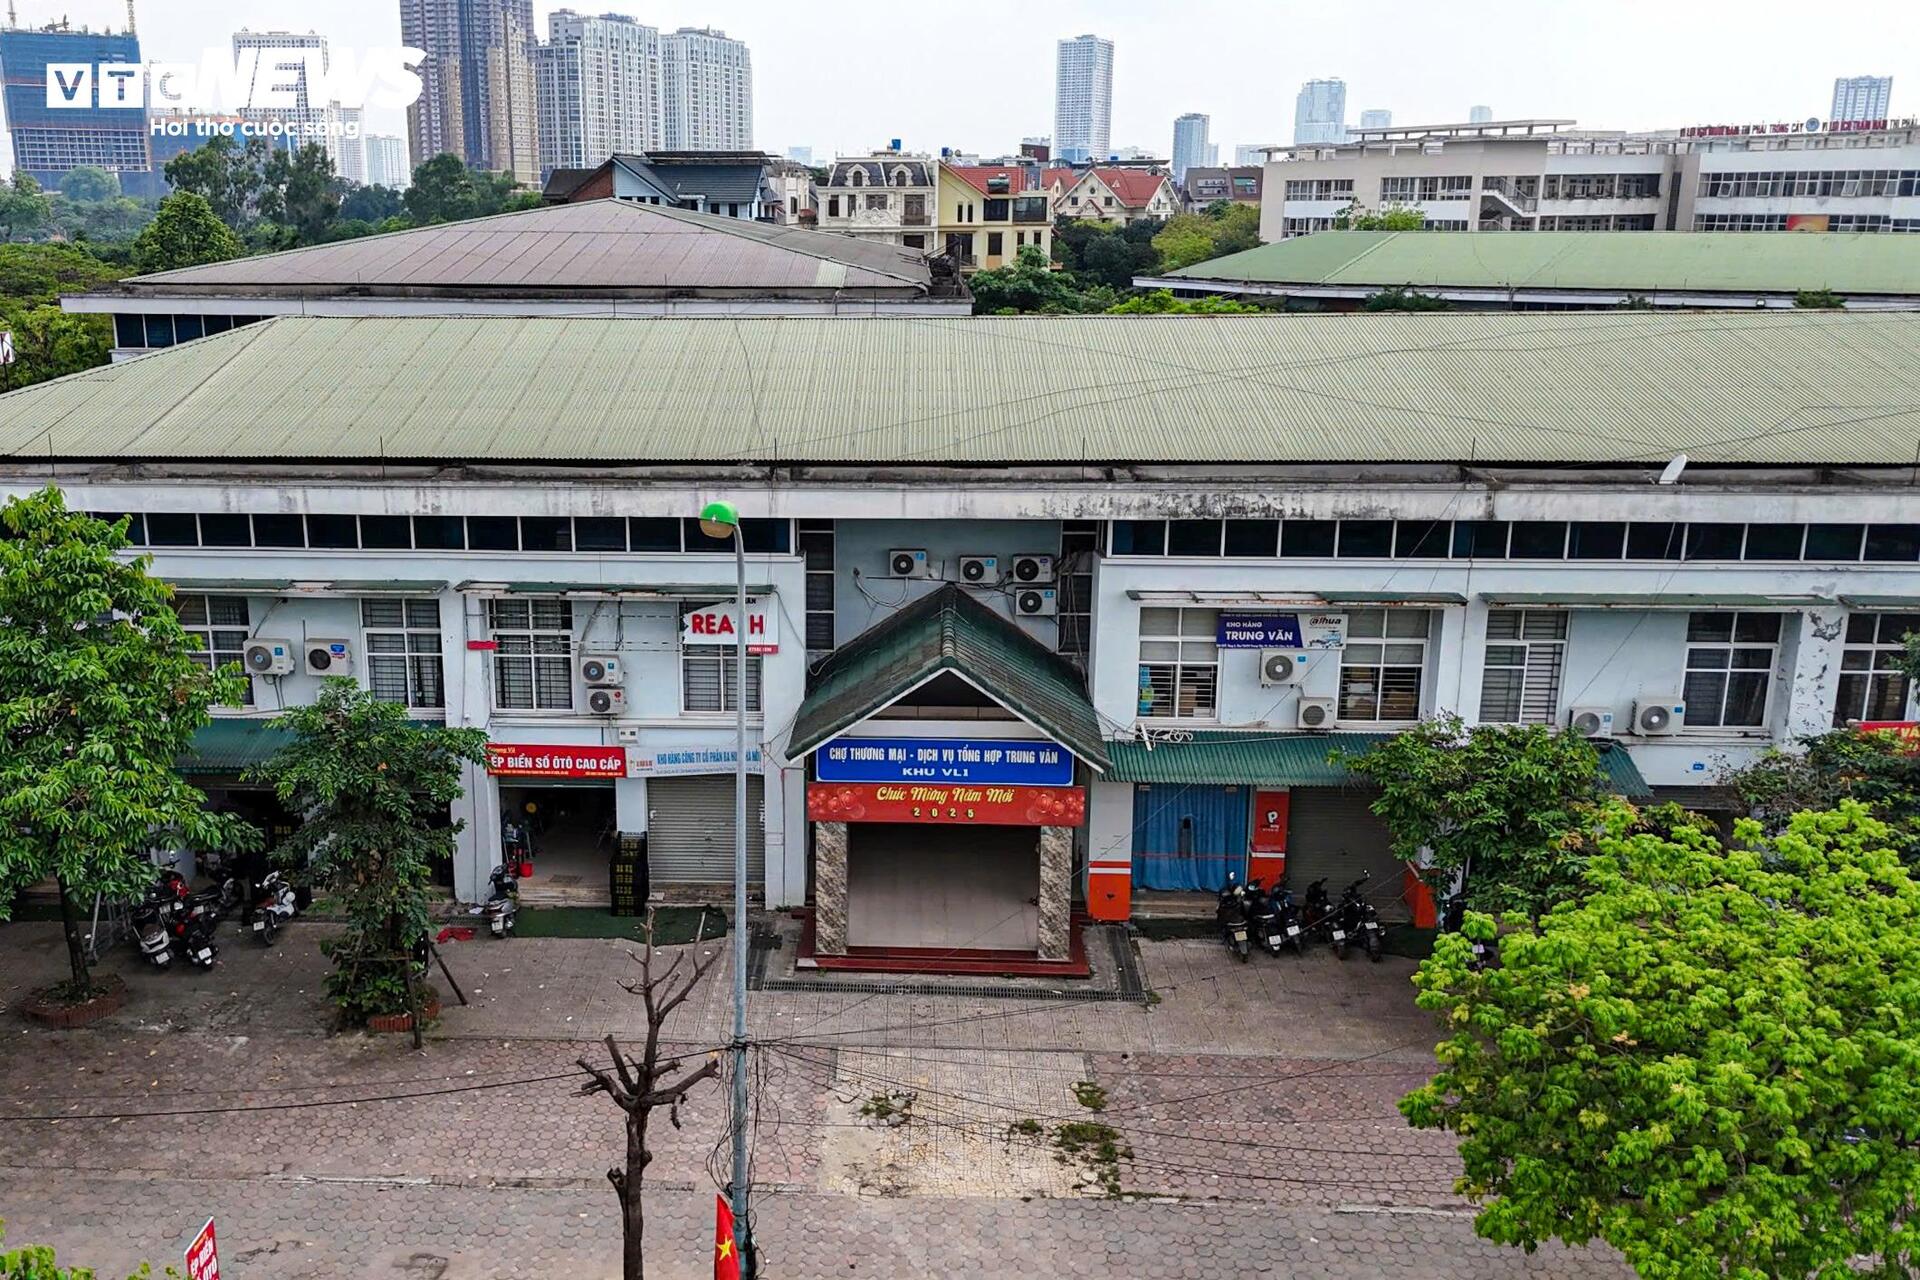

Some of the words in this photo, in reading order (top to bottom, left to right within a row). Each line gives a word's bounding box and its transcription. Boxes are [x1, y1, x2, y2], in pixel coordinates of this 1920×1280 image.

[1225, 631, 1264, 641] TRUNG
[1268, 629, 1293, 641] VĂN
[508, 753, 533, 768] BIỂN
[536, 753, 550, 768] SỐ
[553, 756, 573, 769] ÔTÔ
[576, 758, 597, 770] CAO
[600, 755, 621, 770] CẤP
[829, 747, 847, 763] CHỢ
[850, 746, 885, 760] THƯƠNG
[888, 748, 907, 764] MẠI
[917, 749, 939, 764] DỊCH
[942, 749, 955, 764] VỤ
[957, 744, 981, 762] TỔNG
[984, 750, 1003, 765] HỢP
[1005, 751, 1036, 763] TRUNG
[1039, 748, 1059, 764] VĂN
[902, 768, 936, 776] KHU
[877, 786, 908, 801] Chúc
[910, 786, 949, 805] Mừng
[952, 788, 983, 804] Năm
[986, 789, 1015, 804] Mới
